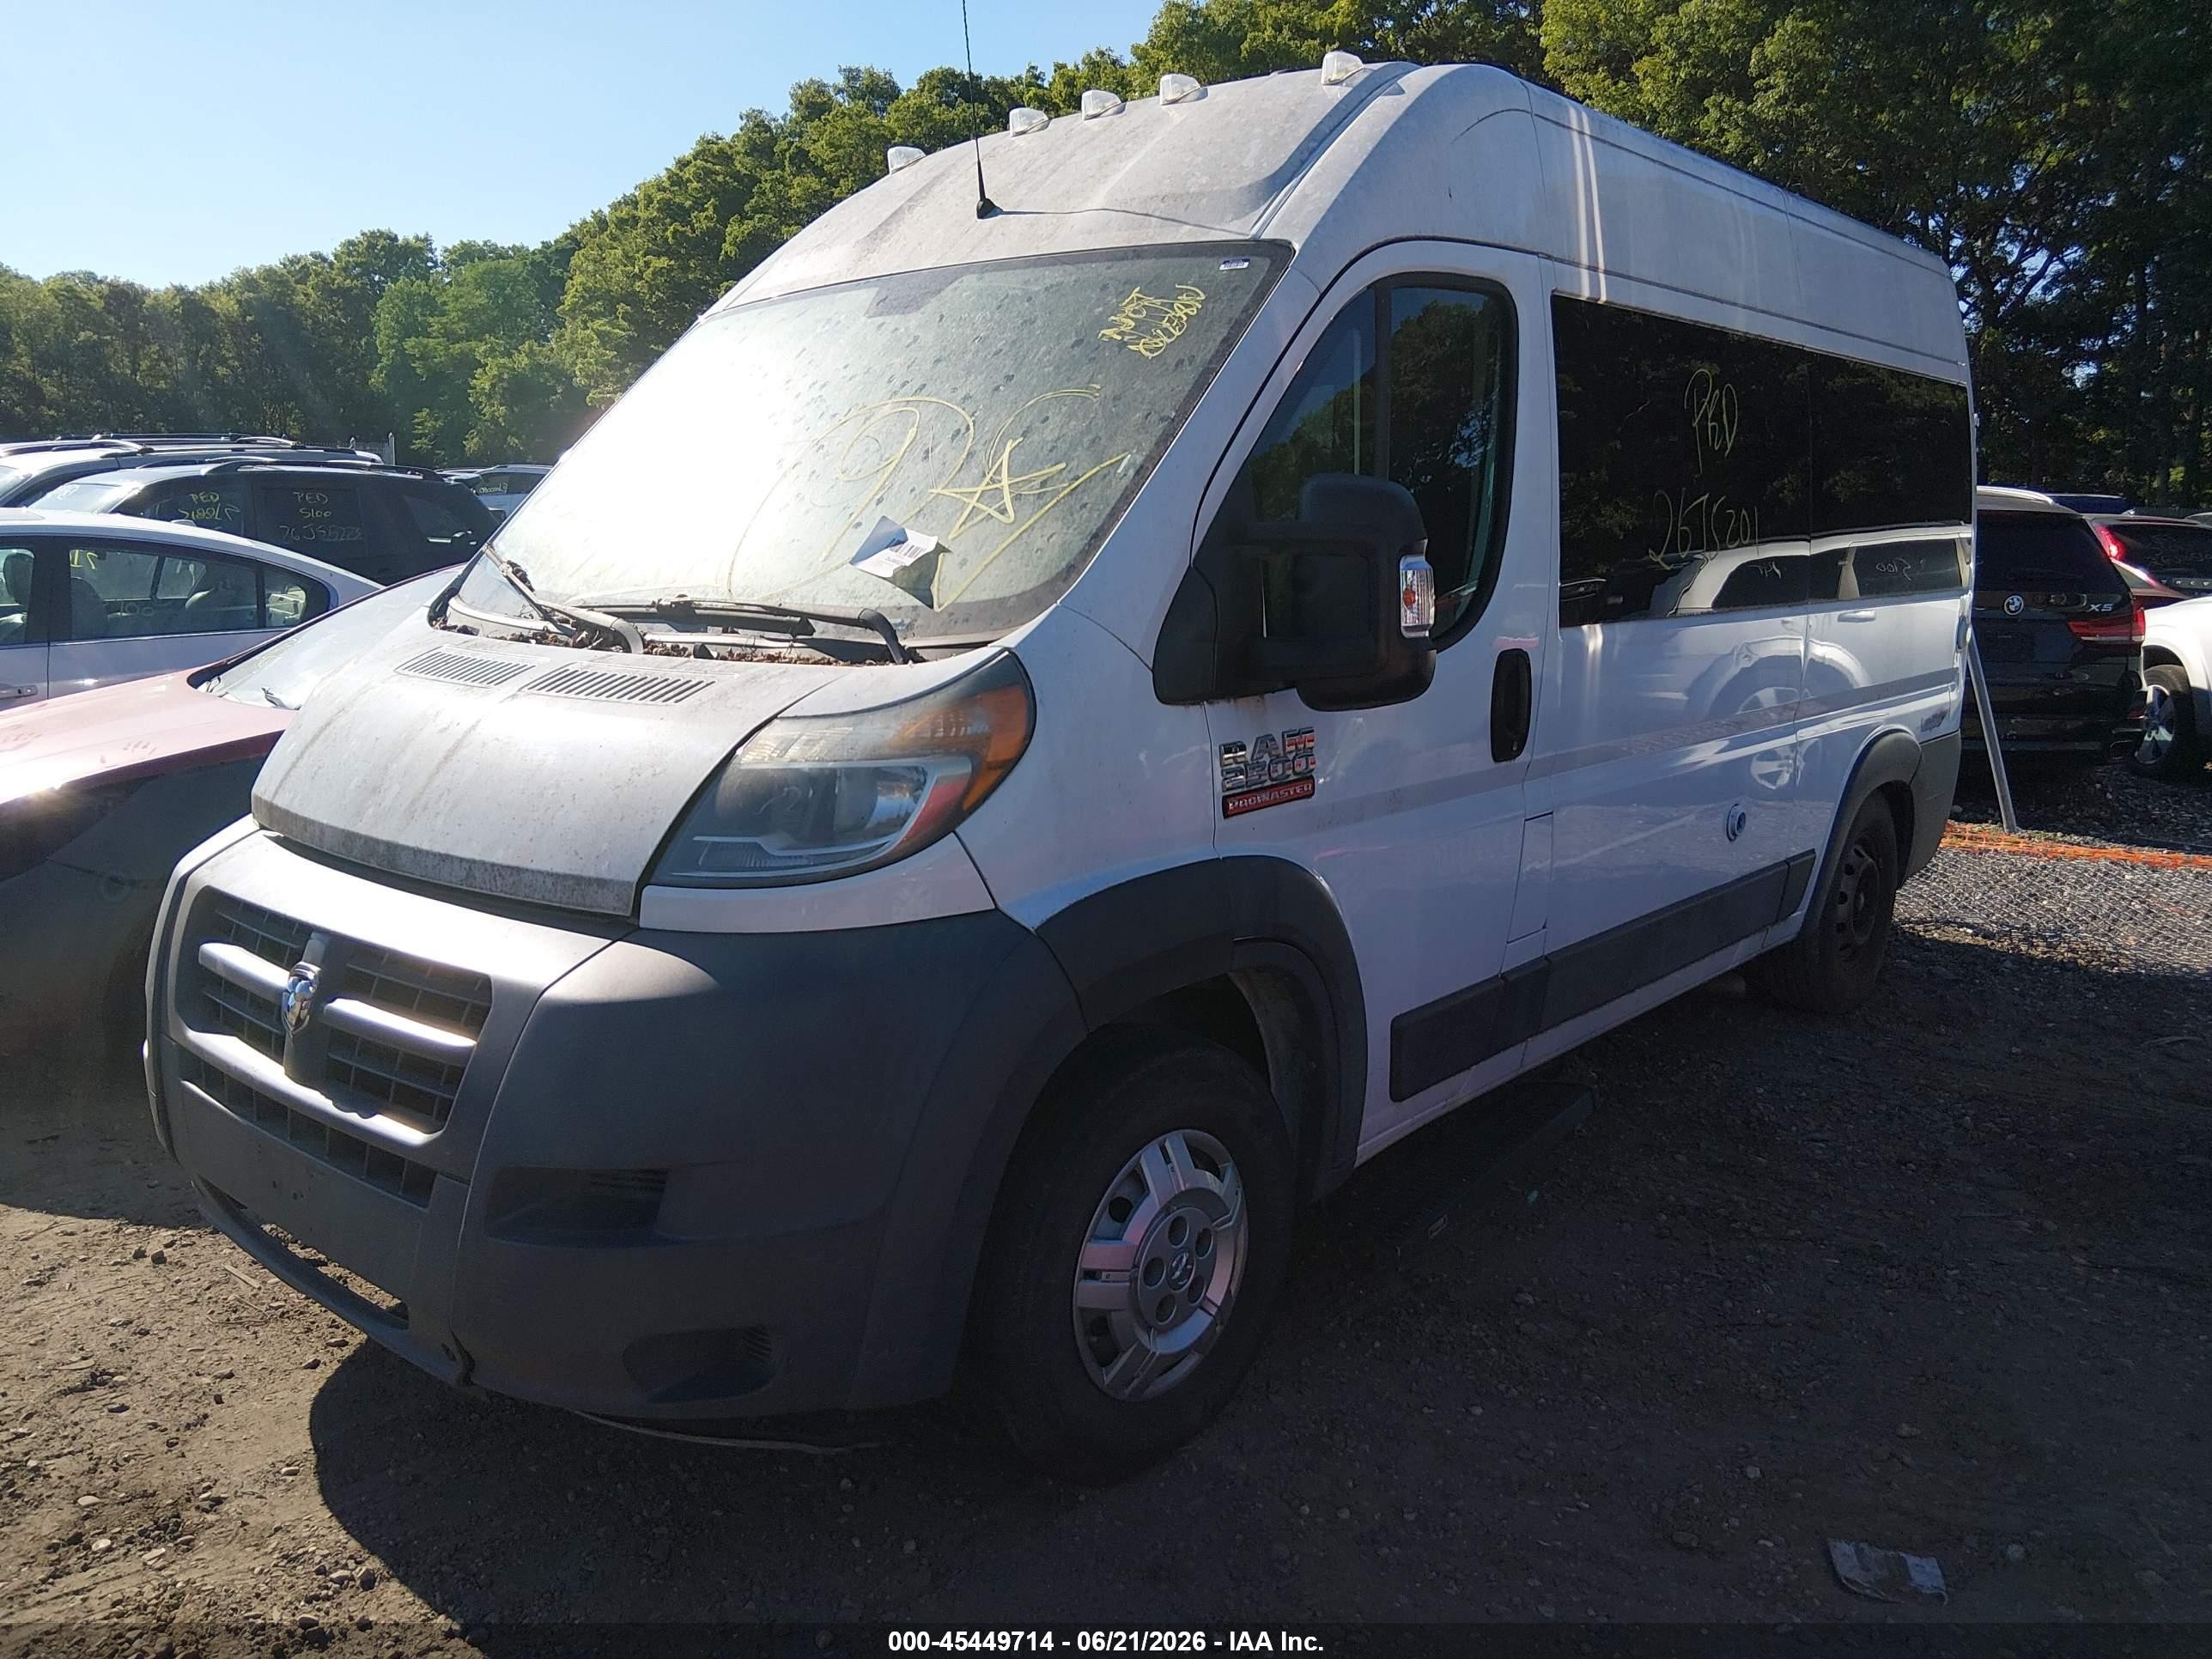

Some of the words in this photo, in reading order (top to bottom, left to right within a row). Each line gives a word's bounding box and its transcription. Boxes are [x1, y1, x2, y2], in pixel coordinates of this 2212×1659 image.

[2087, 604, 2114, 612] X5
[1218, 726, 1316, 767] RAM
[1227, 782, 1314, 811] PROMASTER
